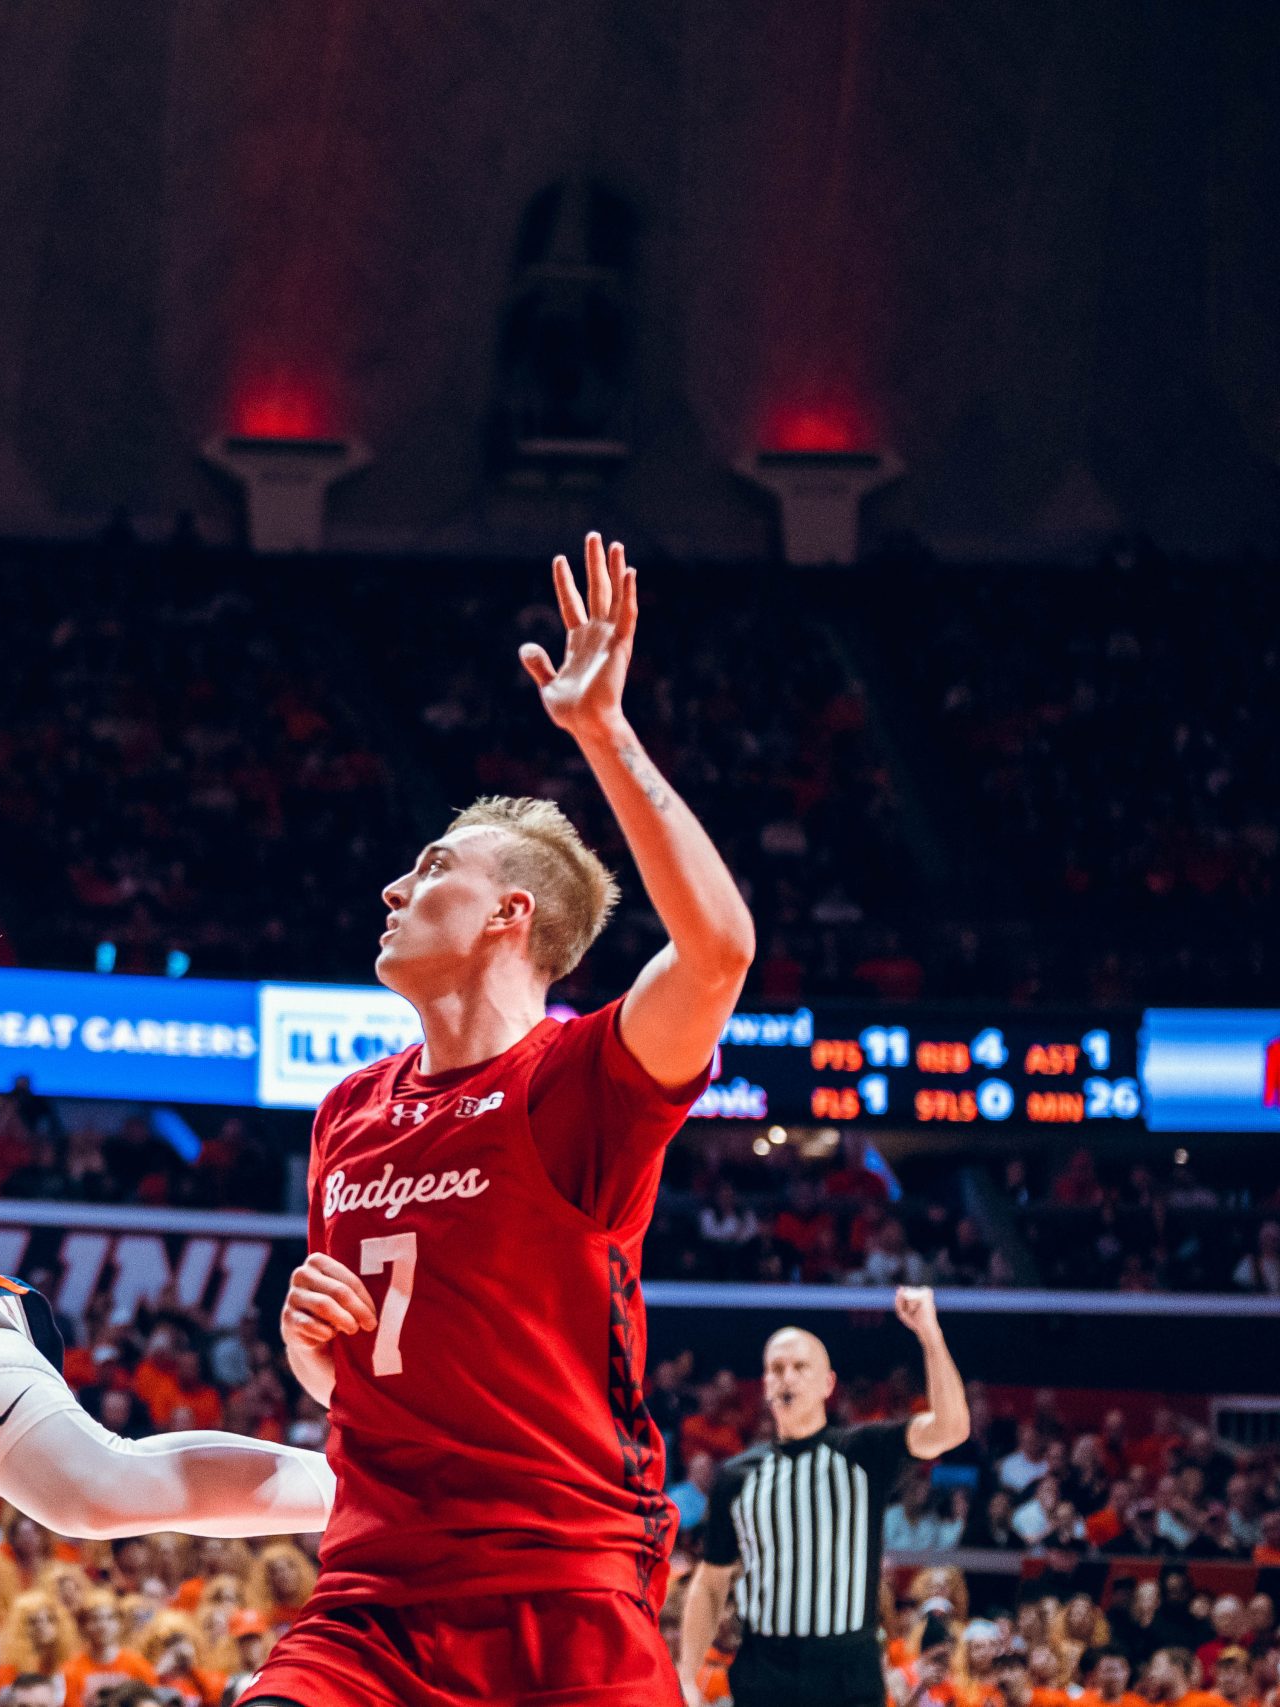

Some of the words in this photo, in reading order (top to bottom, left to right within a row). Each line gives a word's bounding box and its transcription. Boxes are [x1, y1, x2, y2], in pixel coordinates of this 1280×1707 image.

[81, 1016, 257, 1060] CAREERS
[811, 1039, 862, 1072] PTS
[860, 1025, 909, 1067] 11
[916, 1041, 970, 1074] REB
[971, 1027, 1008, 1069] 4
[1025, 1043, 1079, 1075] AST
[1081, 1029, 1110, 1070] 1
[858, 1073, 888, 1115] 1
[914, 1088, 977, 1122] STLS
[976, 1077, 1014, 1121] 0
[1026, 1091, 1084, 1123] MIN
[1083, 1076, 1141, 1120] 26
[323, 1162, 490, 1219] Badgers
[360, 1232, 418, 1378] 7
